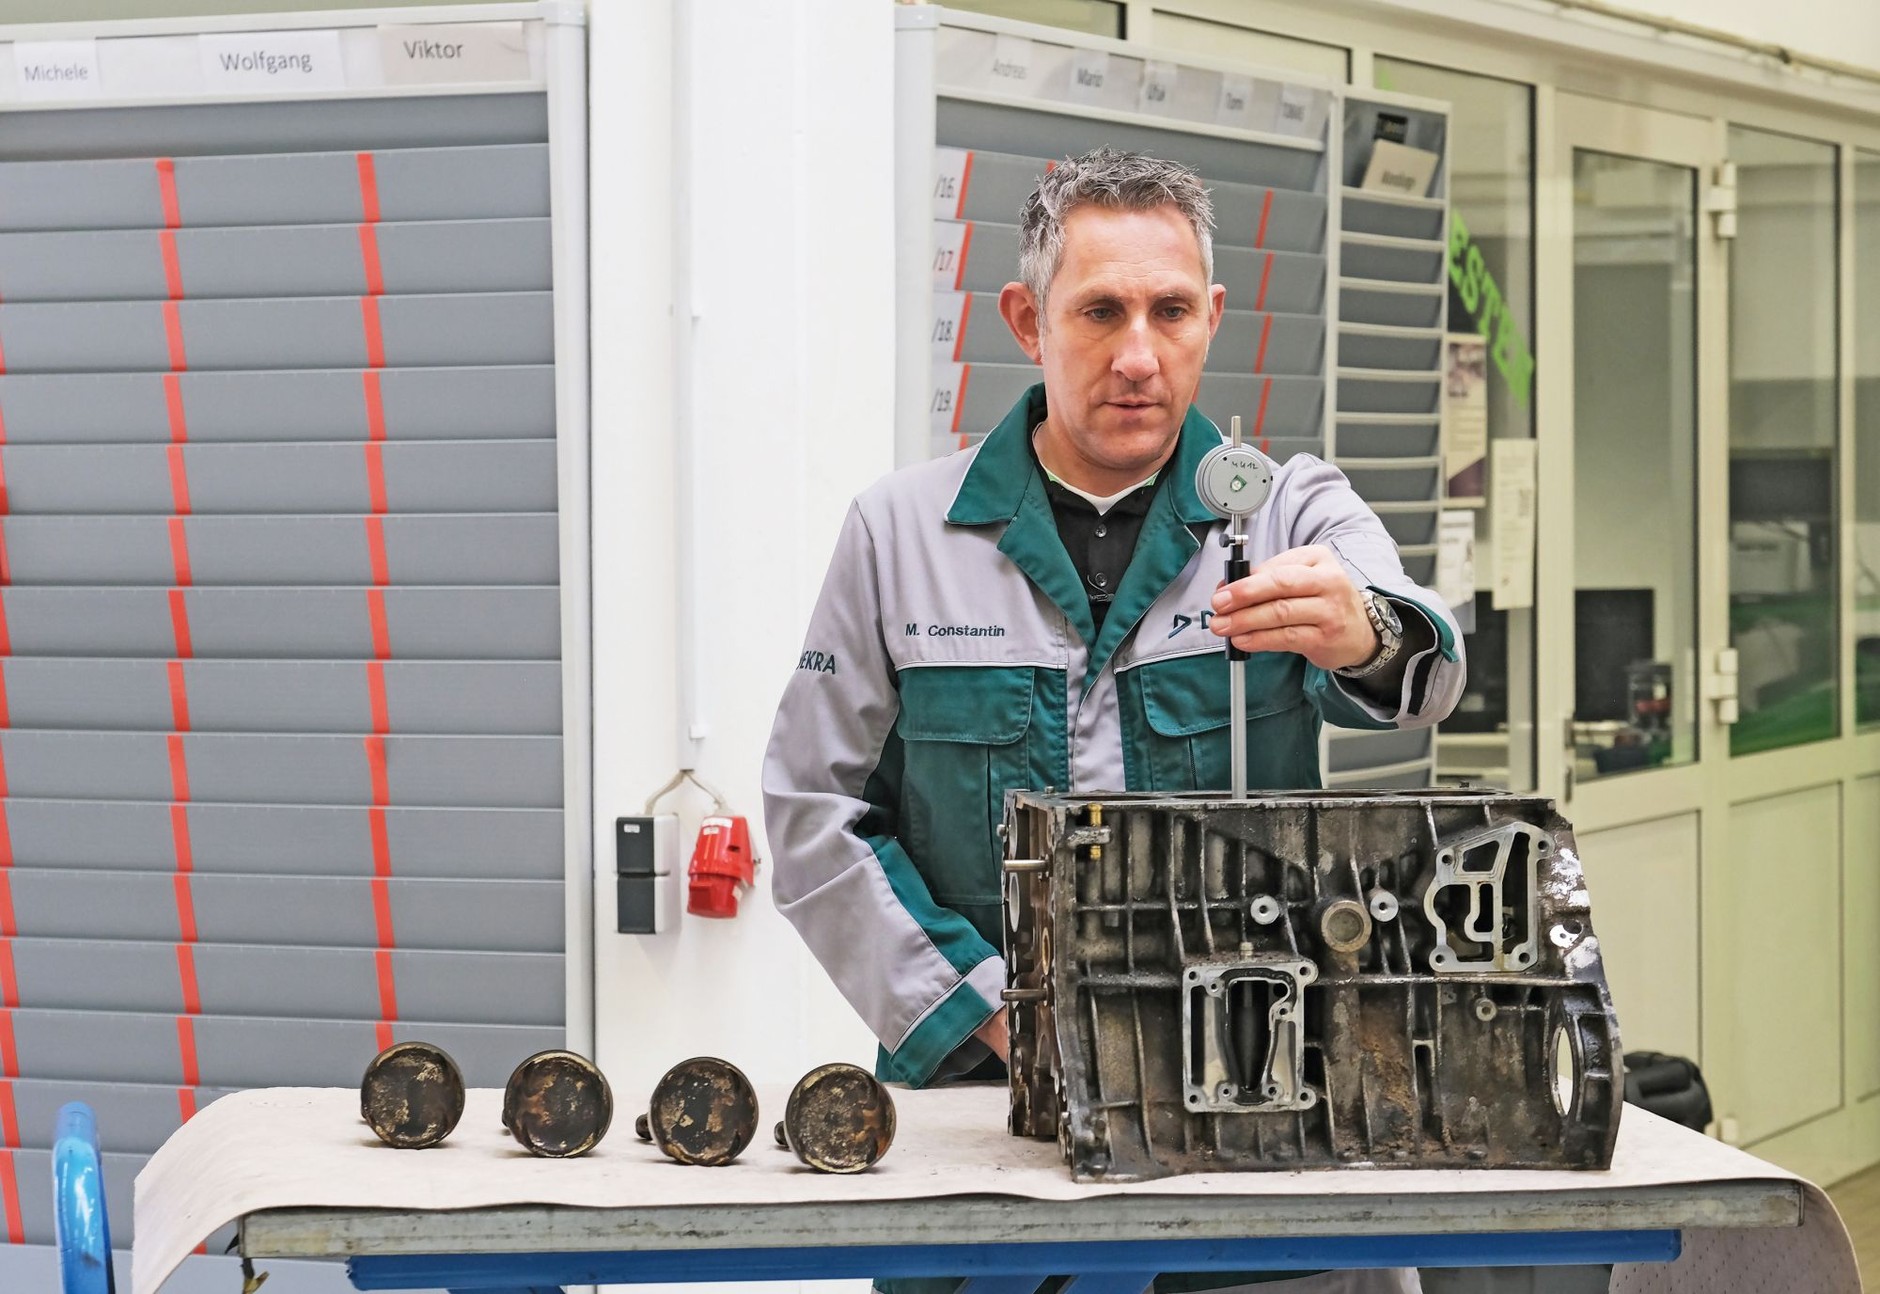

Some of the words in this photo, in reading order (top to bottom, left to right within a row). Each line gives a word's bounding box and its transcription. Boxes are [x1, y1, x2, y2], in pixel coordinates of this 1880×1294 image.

[24, 64, 89, 83] Michele
[219, 50, 313, 74] Wolfgang
[403, 38, 464, 60] Viktor
[905, 622, 920, 637] M.
[927, 624, 1006, 638] Constantin
